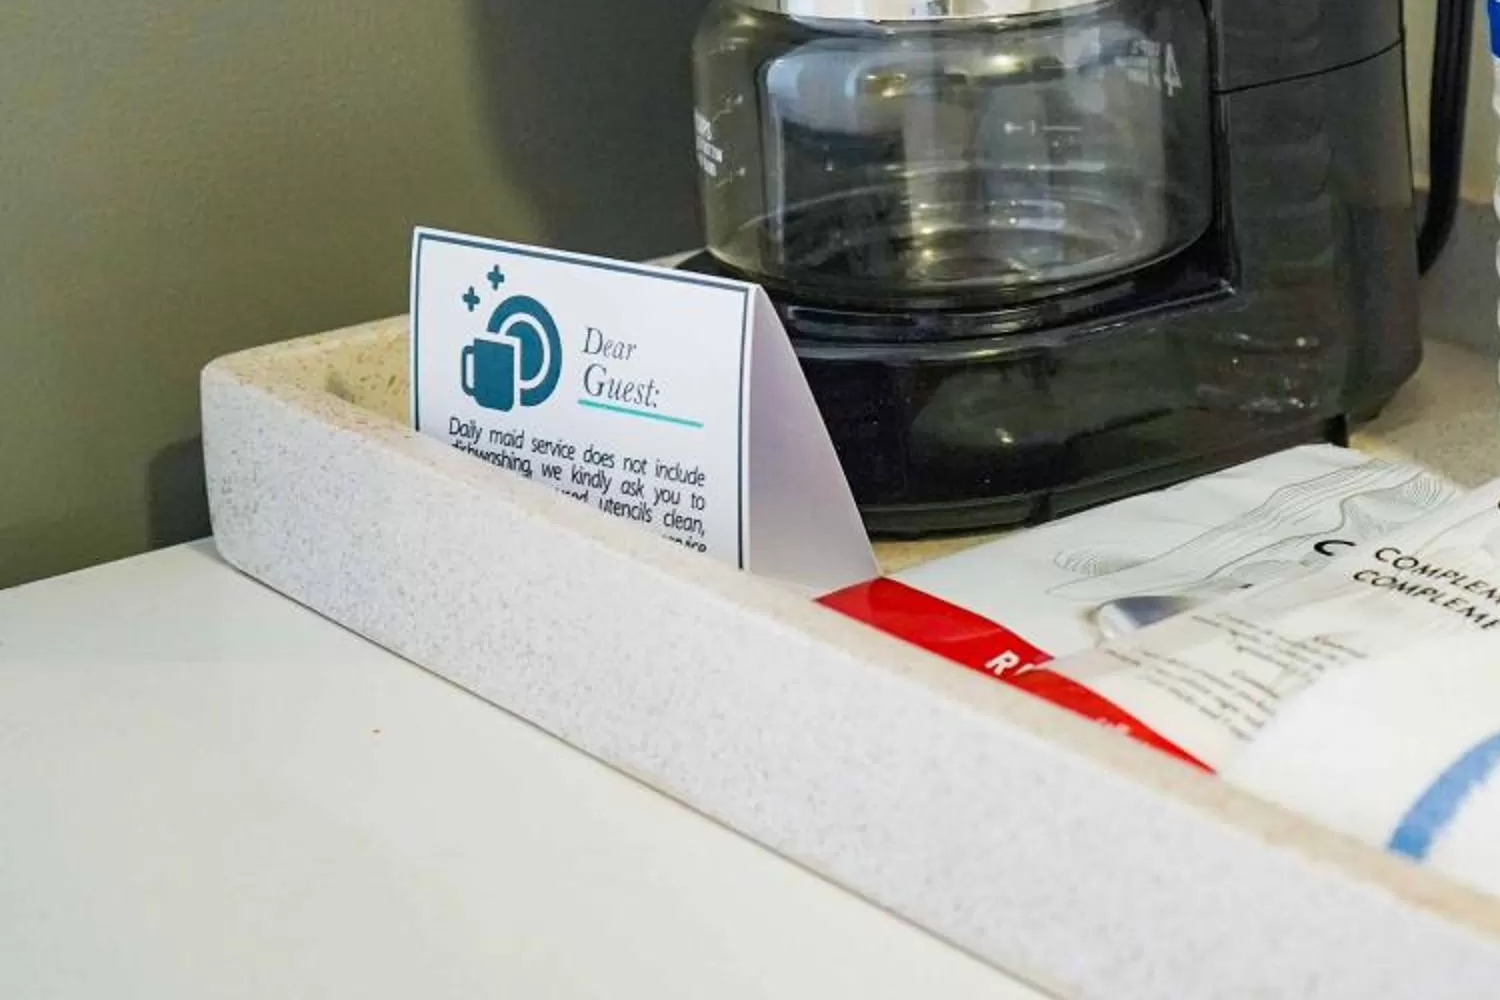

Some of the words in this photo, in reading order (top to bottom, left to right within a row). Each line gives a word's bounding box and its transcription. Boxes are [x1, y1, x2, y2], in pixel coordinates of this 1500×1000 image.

[582, 325, 637, 360] Dear
[583, 362, 660, 408] Guest:
[449, 416, 483, 444] Daily
[489, 428, 525, 449] maid
[531, 437, 576, 461] service
[583, 443, 615, 468] does
[623, 456, 648, 475] not
[655, 458, 705, 487] include
[541, 462, 562, 481] we
[571, 463, 612, 495] kindly
[620, 477, 645, 500] ask
[654, 486, 681, 507] you
[691, 492, 705, 511] to
[663, 508, 705, 537] clean,
